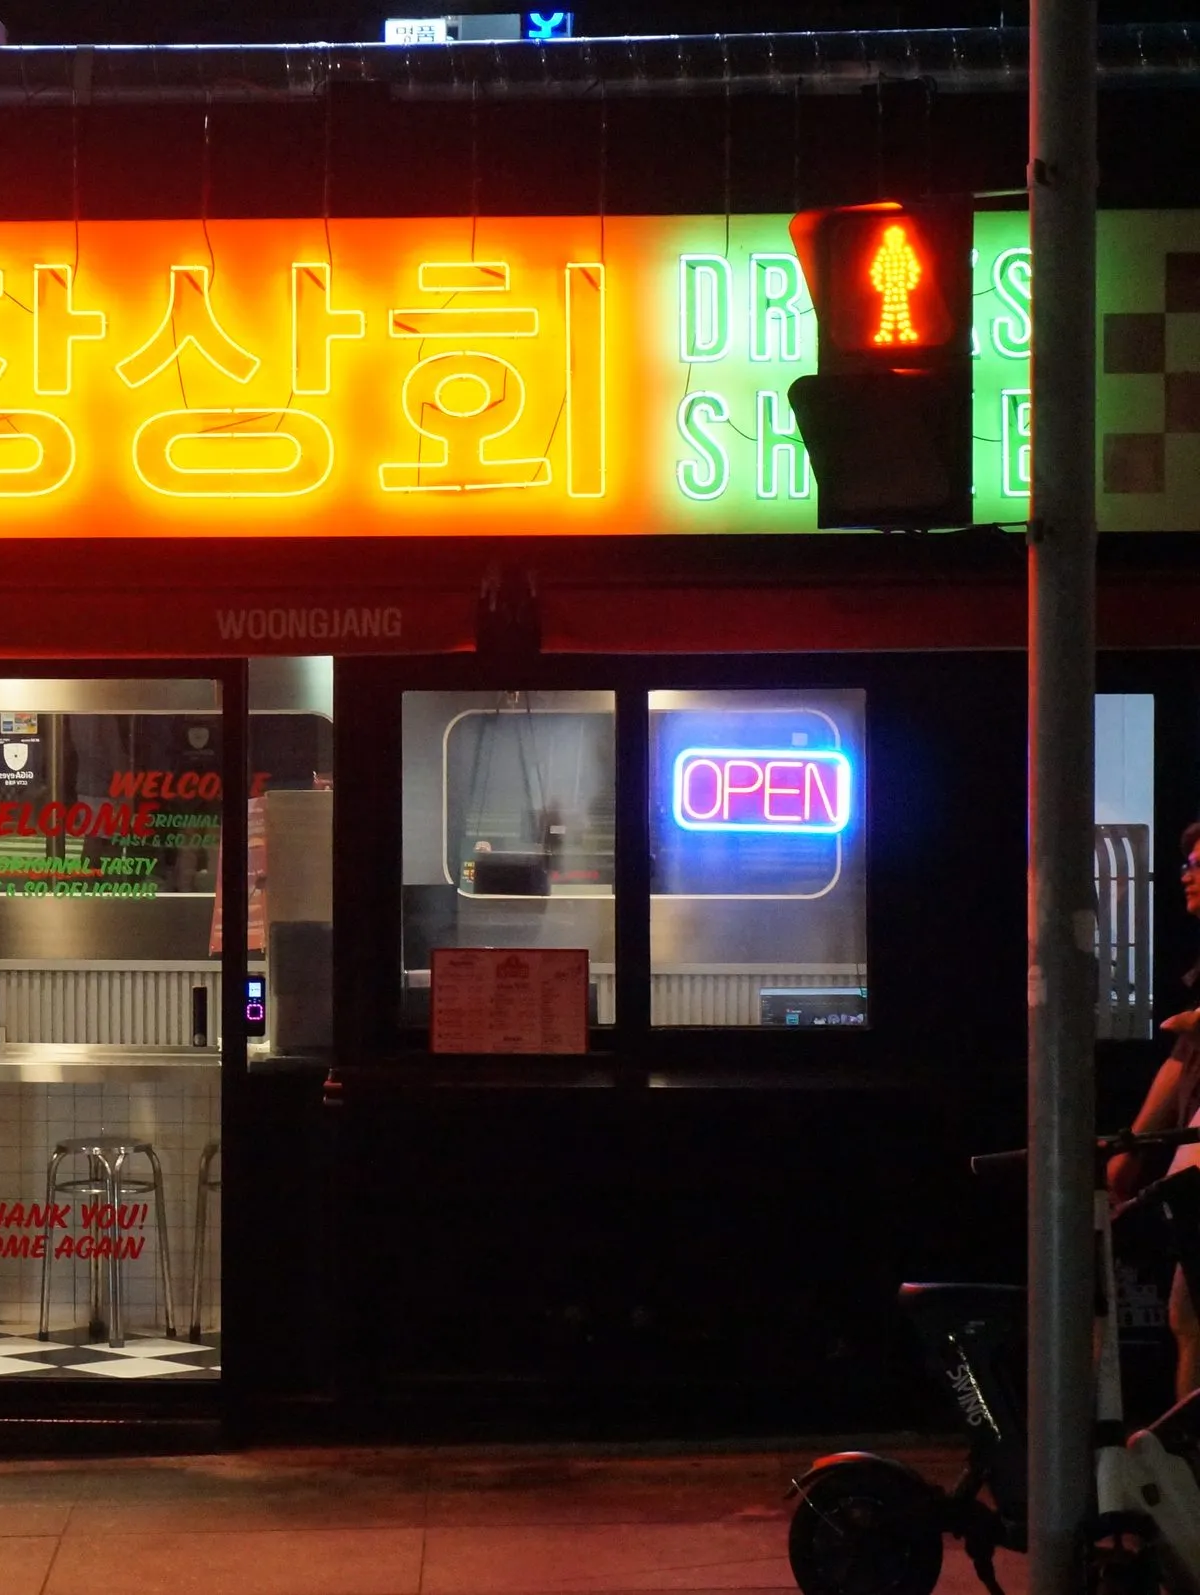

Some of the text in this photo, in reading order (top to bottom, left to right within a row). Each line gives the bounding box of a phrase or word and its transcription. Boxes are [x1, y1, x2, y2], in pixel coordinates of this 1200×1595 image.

[680, 247, 1032, 364] DRS
[677, 389, 1032, 500] SHE
[216, 607, 401, 640] WOONGJANG
[108, 770, 272, 799] WELCOE
[682, 759, 843, 822] OPEN
[99, 857, 157, 875] TASTY
[24, 881, 48, 897] SO
[54, 881, 158, 898] DELICIOUS
[81, 1203, 148, 1230] YOU!
[55, 1235, 145, 1260] AGAIN
